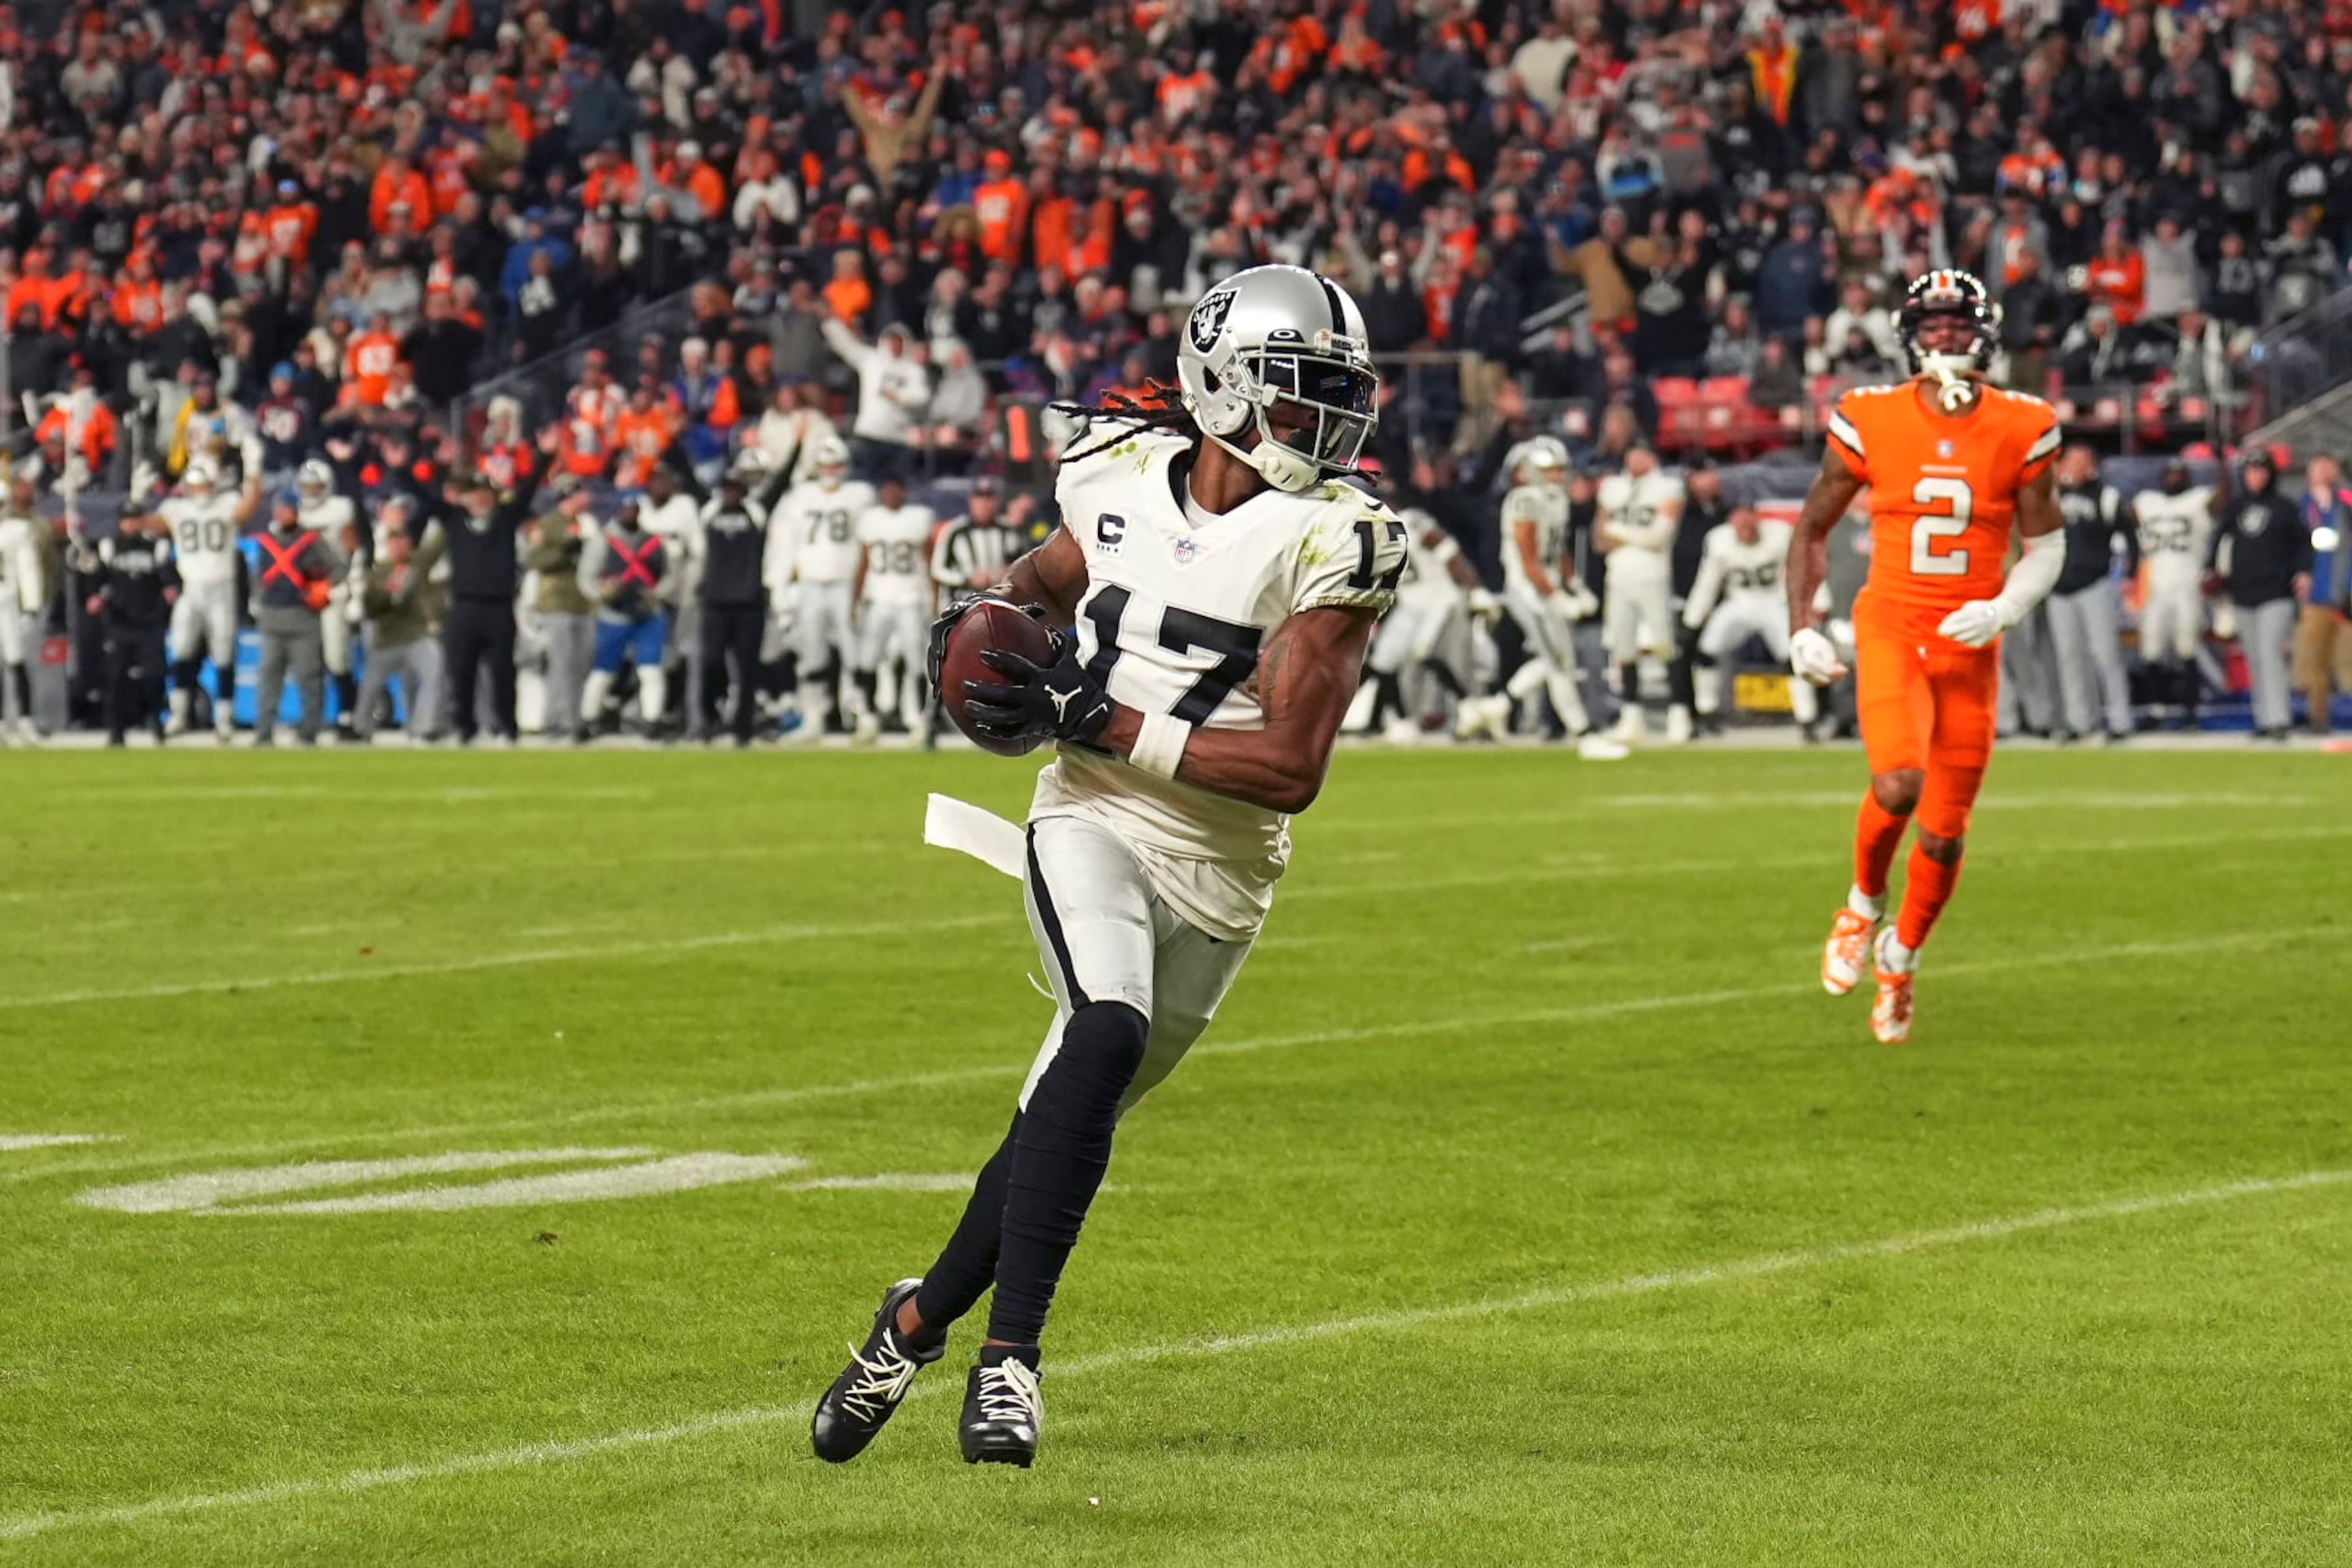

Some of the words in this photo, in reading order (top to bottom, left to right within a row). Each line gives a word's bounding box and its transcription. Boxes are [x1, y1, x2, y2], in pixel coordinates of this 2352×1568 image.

[178, 518, 228, 553] 80
[805, 509, 850, 544] 78
[1098, 513, 1125, 545] C
[1910, 476, 1972, 576] 2
[1348, 521, 1408, 589] 17
[1083, 584, 1264, 728] 17
